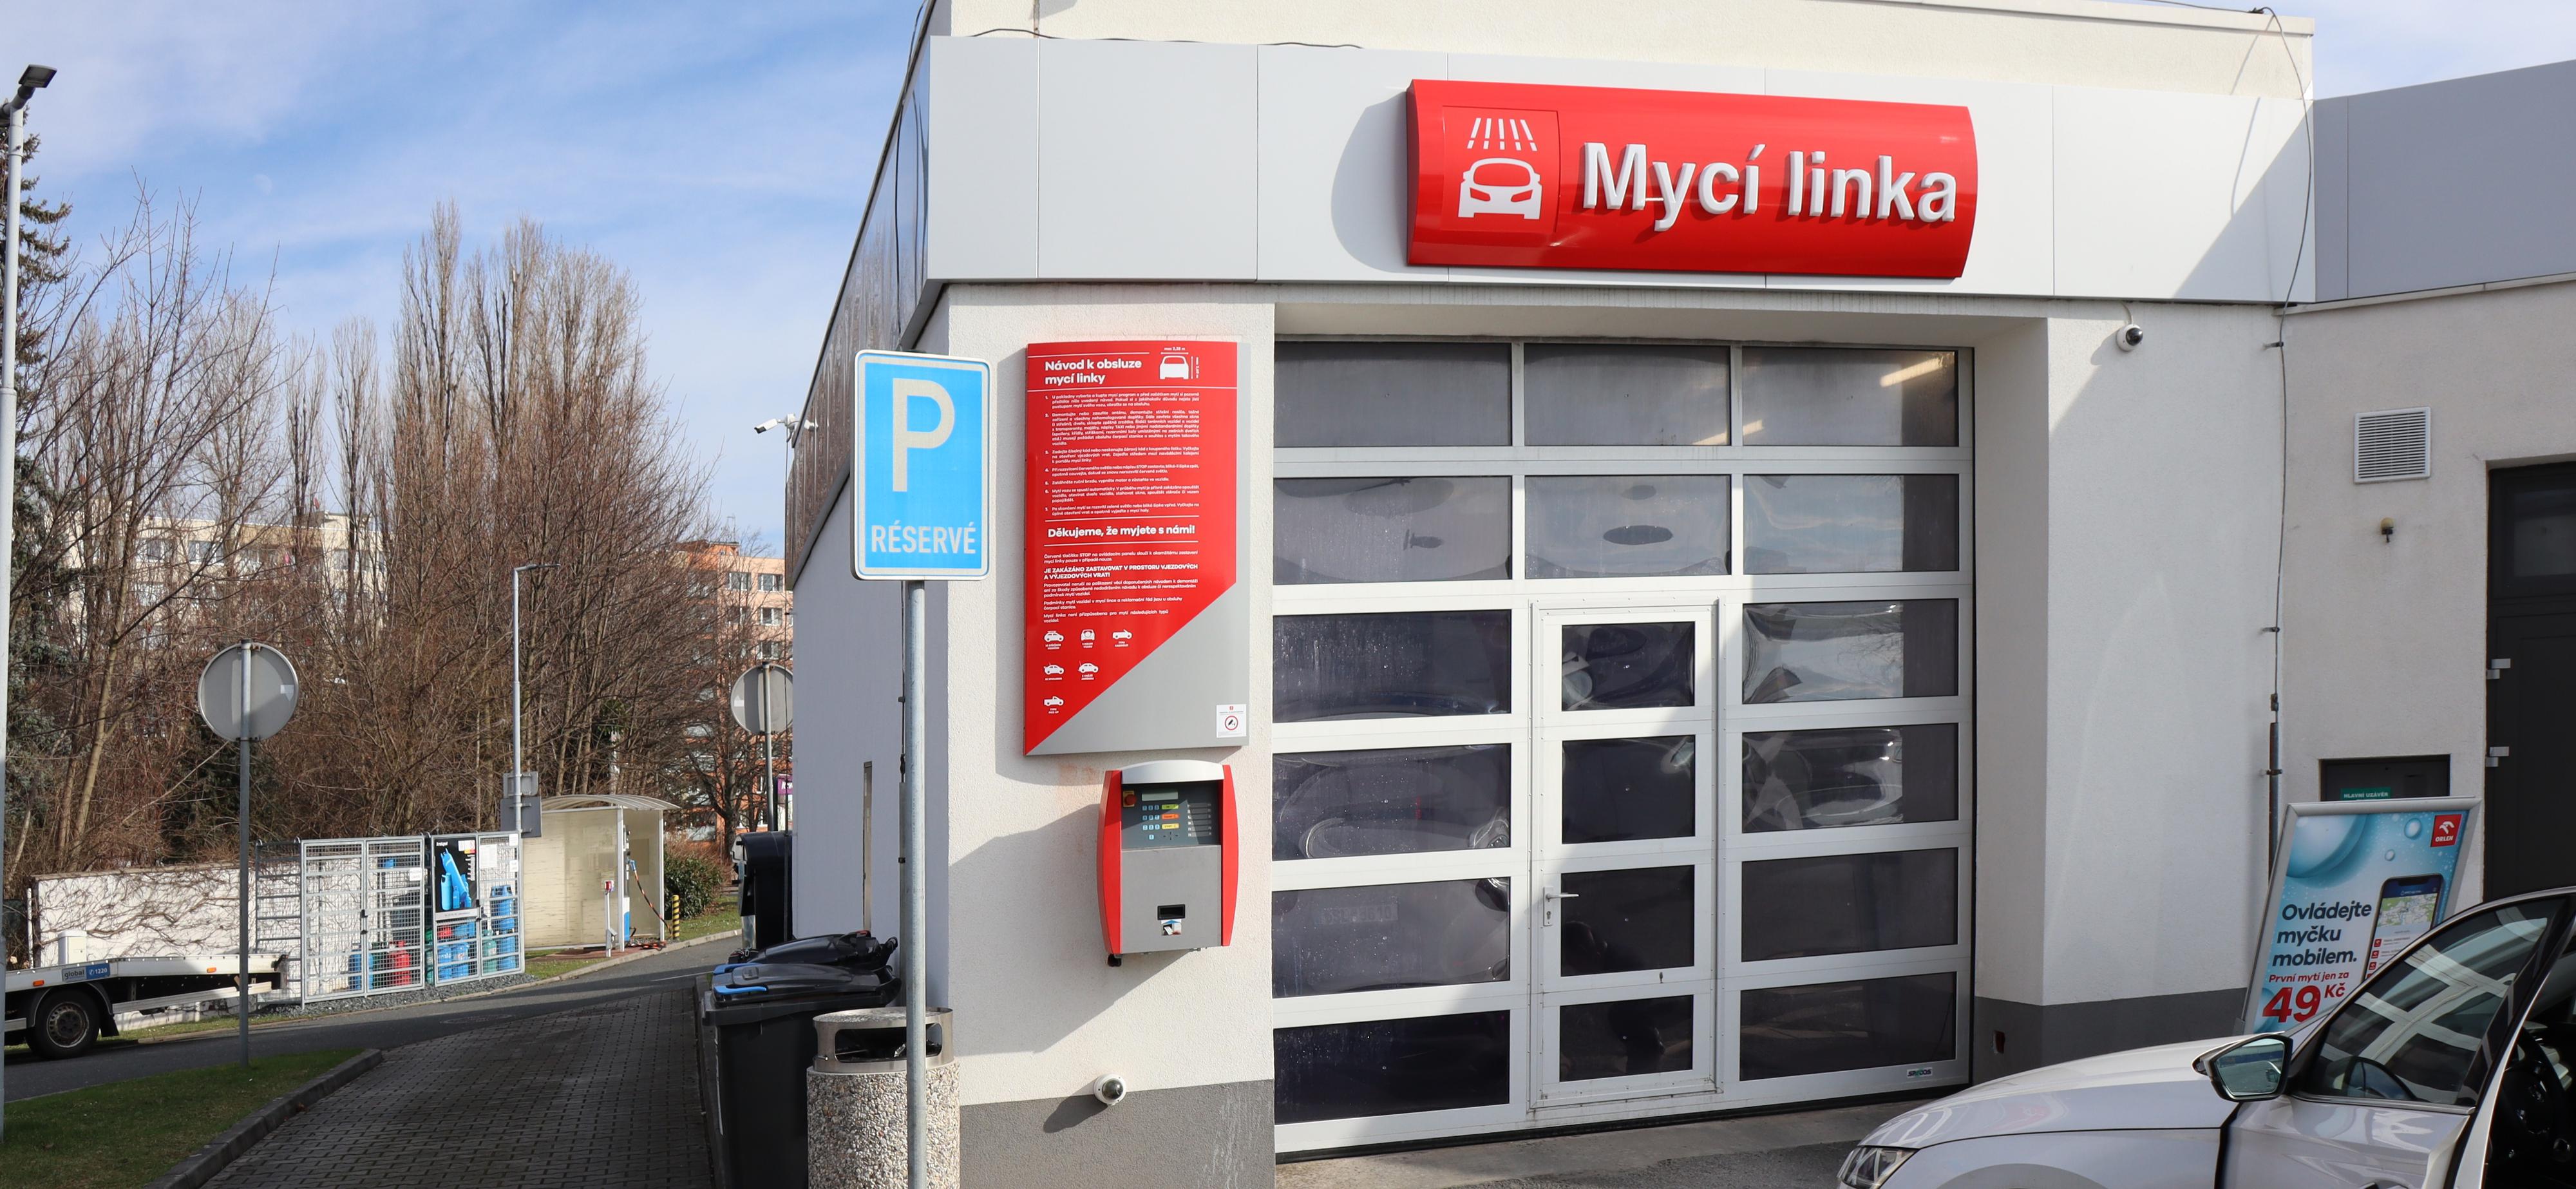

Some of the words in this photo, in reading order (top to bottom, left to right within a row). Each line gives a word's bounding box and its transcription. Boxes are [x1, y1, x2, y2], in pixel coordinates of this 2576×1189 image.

[1584, 142, 1765, 232] Mycí
[1788, 151, 1956, 223] linka
[1045, 359, 1084, 371] Návod
[1087, 359, 1095, 369] k
[1097, 358, 1142, 369] obsluze
[1045, 373, 1075, 386] mycí
[1077, 372, 1106, 385] linky
[893, 377, 955, 492] P
[871, 520, 976, 555] RÉSERVÉ
[1048, 527, 1104, 538] Děkujeme,
[1106, 526, 1118, 536] že
[1121, 526, 1157, 537] myjete
[1166, 525, 1195, 534] námi!
[2282, 900, 2372, 922] Ovládejte
[2277, 926, 2342, 947] myčku
[2272, 947, 2357, 966] mobilem.
[64, 969, 85, 979] global
[2269, 971, 2295, 983] První
[2297, 971, 2320, 983] mytí
[2321, 971, 2336, 982] jen
[2262, 985, 2321, 1023] 49
[2324, 982, 2346, 999] Kč
